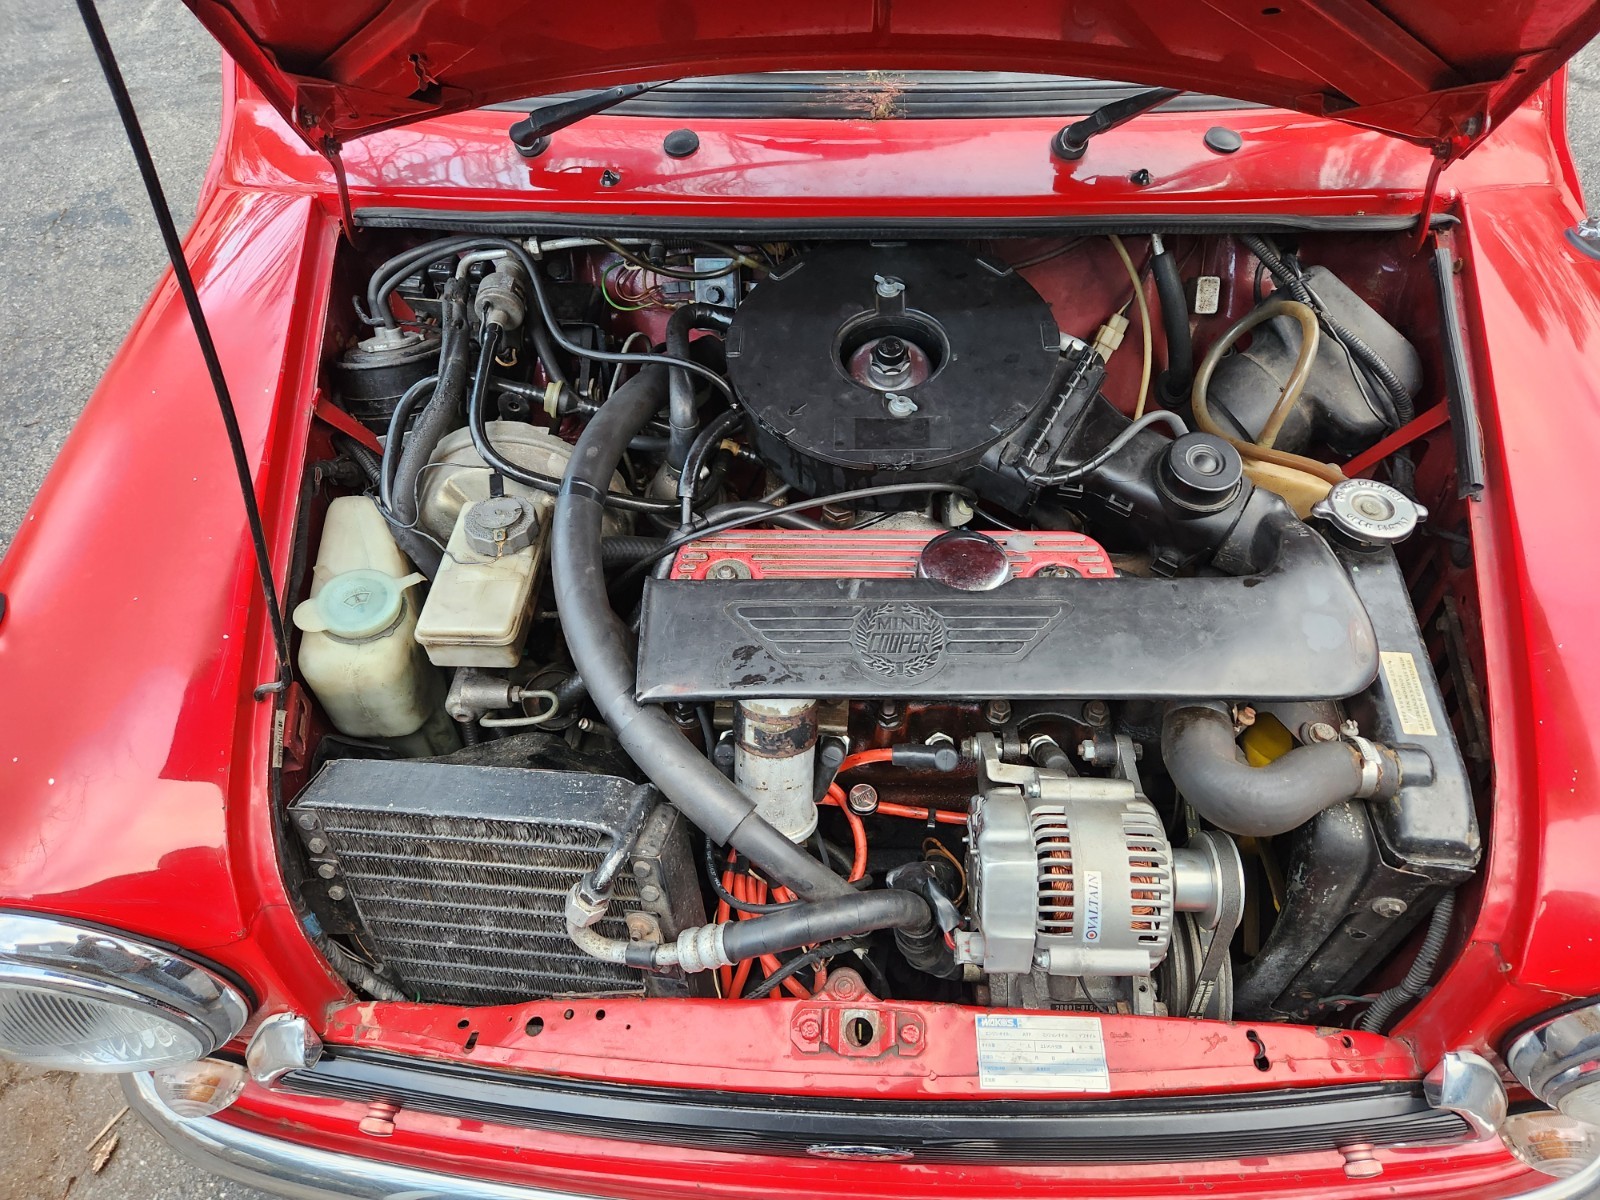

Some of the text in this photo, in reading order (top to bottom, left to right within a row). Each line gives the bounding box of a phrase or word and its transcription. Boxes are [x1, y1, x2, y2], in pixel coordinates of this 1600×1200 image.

[877, 617, 922, 630] MINI
[867, 632, 931, 653] COOPER
[1088, 874, 1099, 929] VALTAIN
